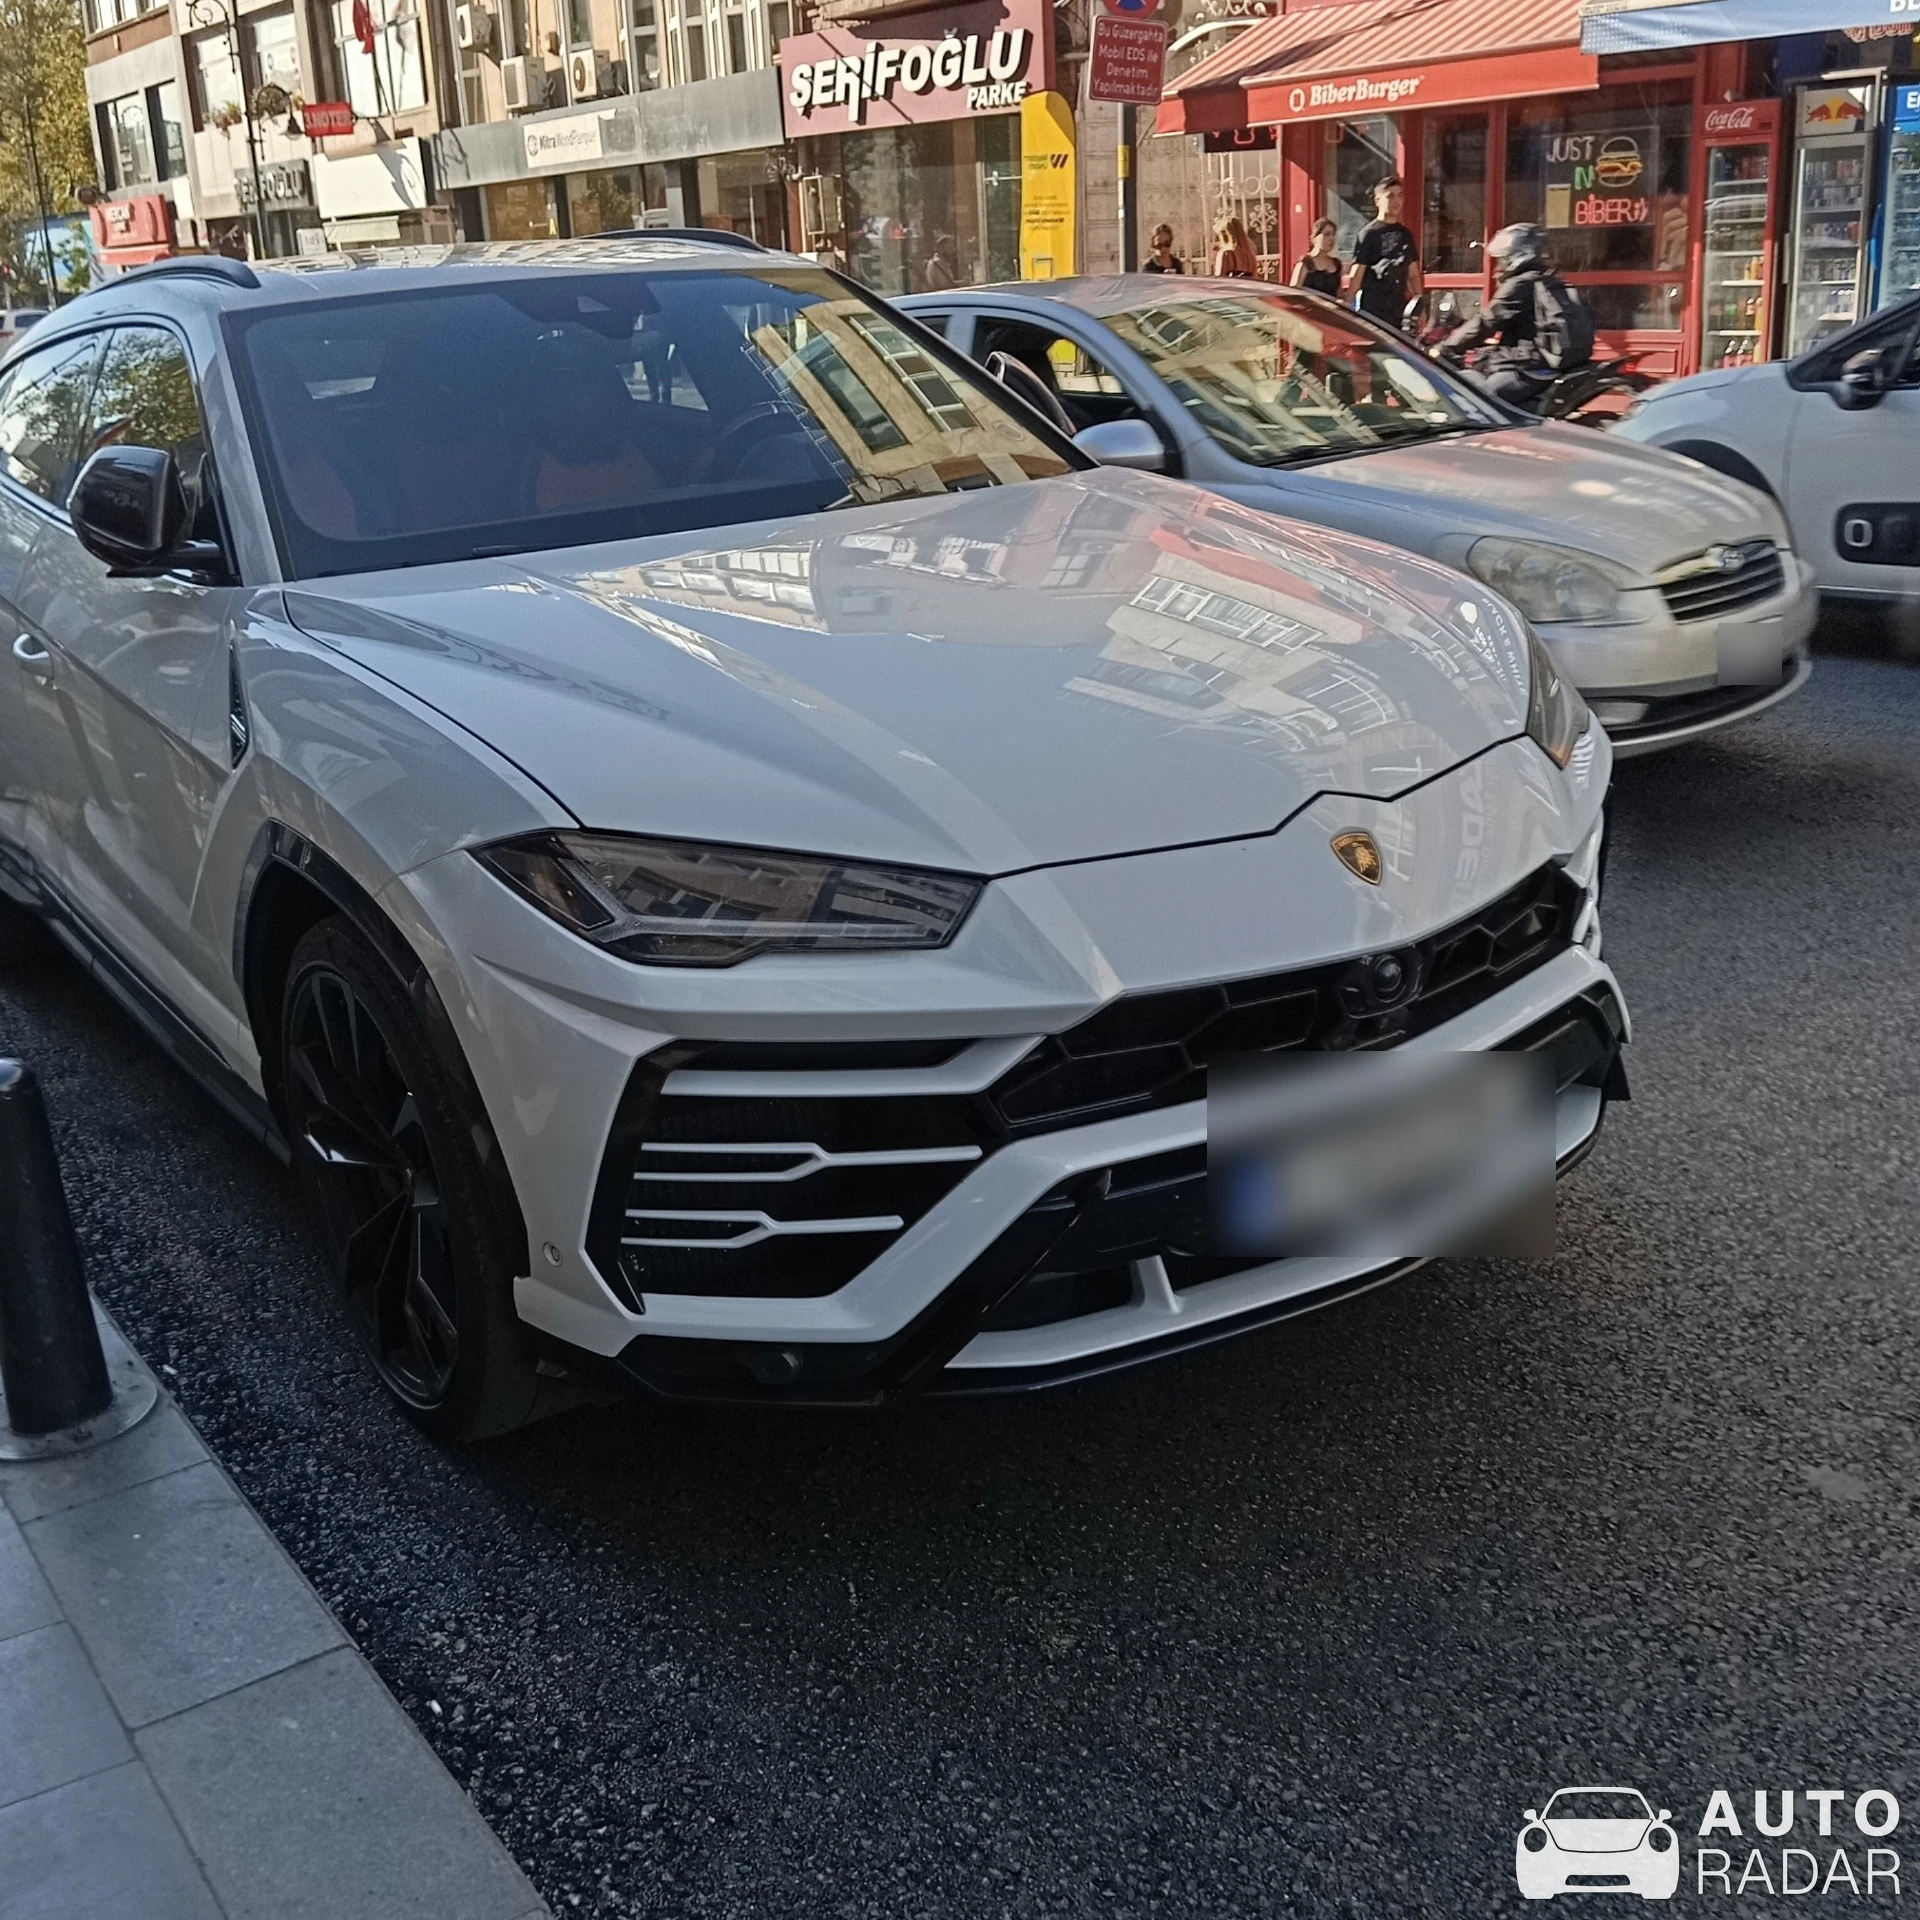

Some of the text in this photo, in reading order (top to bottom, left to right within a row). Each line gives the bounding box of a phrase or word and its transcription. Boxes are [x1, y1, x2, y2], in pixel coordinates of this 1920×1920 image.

[1098, 22, 1163, 44] Bu Güzergahta
[1098, 44, 1159, 63] Mobil EDS ile
[1106, 61, 1148, 78] Denetim
[967, 81, 1027, 110] PARKE
[1309, 78, 1420, 107] BiberBurger
[1546, 136, 1595, 162] JUST
[1574, 165, 1595, 190] N
